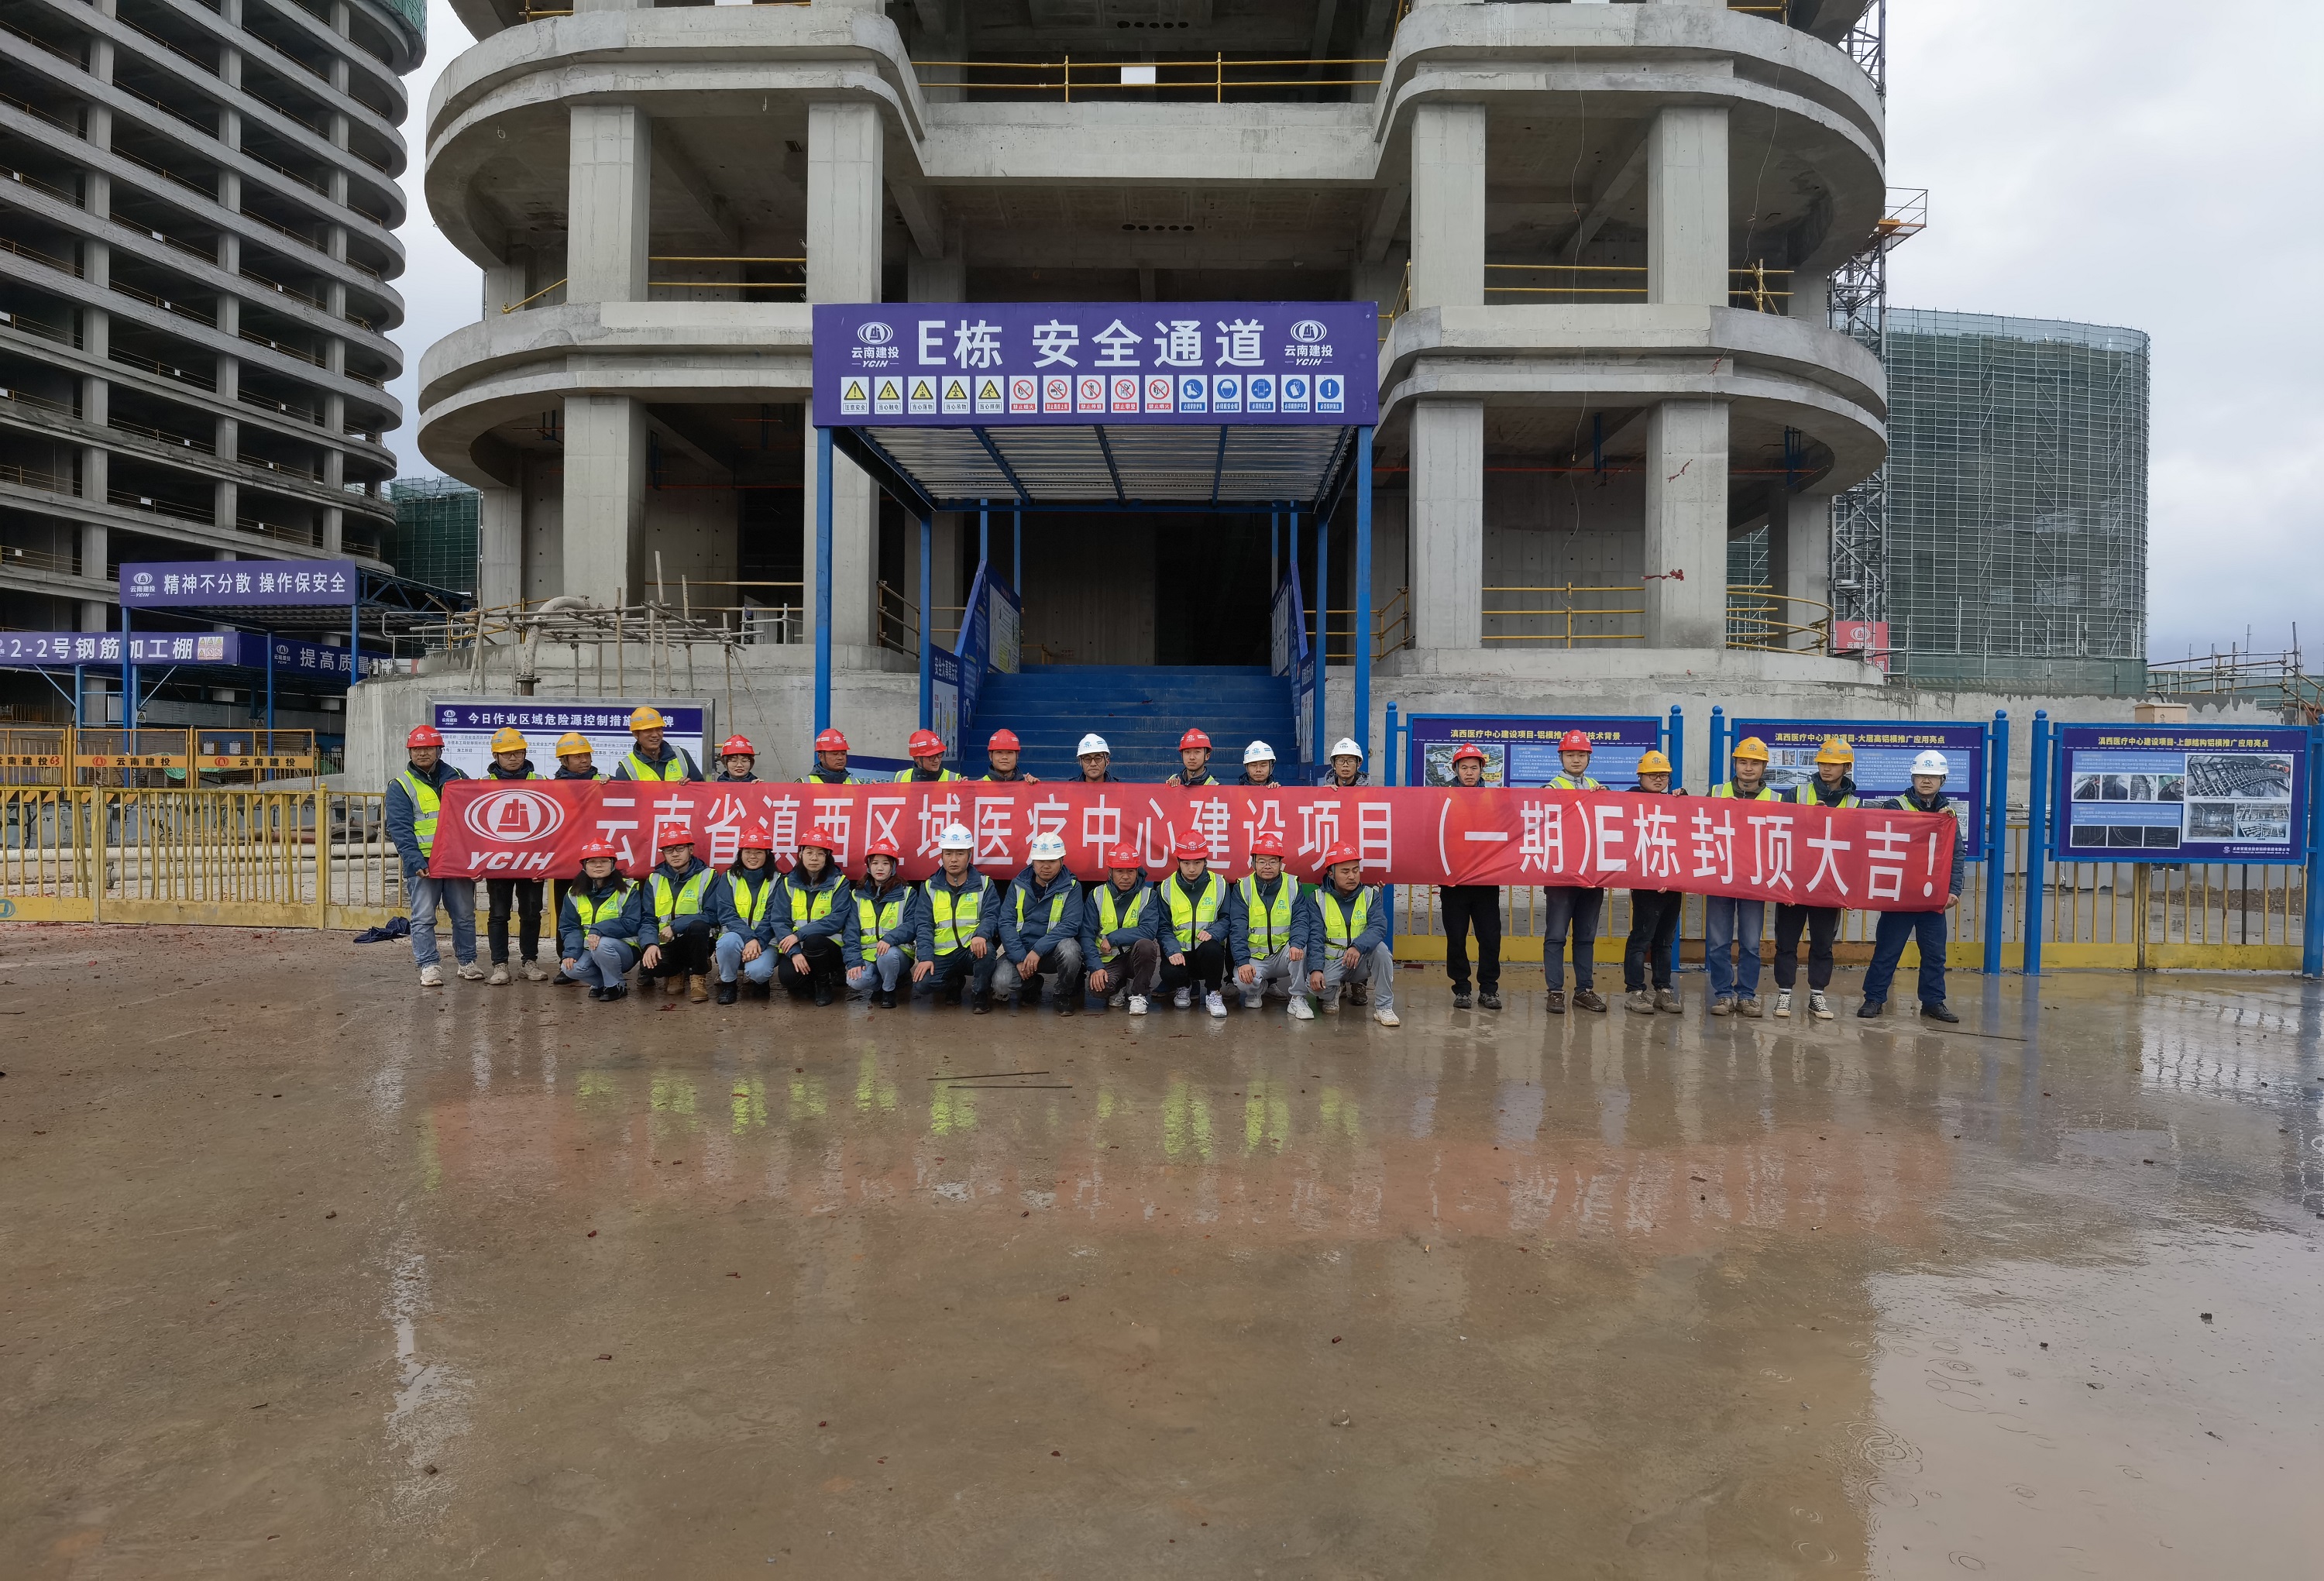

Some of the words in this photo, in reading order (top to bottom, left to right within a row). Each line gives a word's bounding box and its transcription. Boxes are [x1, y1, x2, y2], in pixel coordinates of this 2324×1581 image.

[918, 319, 1003, 369] E栋
[1032, 318, 1265, 369] 安全通道
[851, 346, 899, 359] 云南建投
[1284, 345, 1333, 357] 云南建投
[163, 572, 251, 594] 精神不分散
[260, 572, 346, 593] 操作保安全
[10, 637, 193, 659] 2-2号钢筋加工棚
[300, 647, 370, 674] 提高质量
[468, 712, 675, 727] 今日作业区域危险源控制措施牌
[1450, 729, 1621, 741] 滇西医疗中心建设项目-铝模推技术背景
[0, 757, 47, 766] 南建投
[116, 757, 170, 767] 云南建投
[239, 758, 296, 767] 云南建投
[466, 851, 555, 871] YCIH
